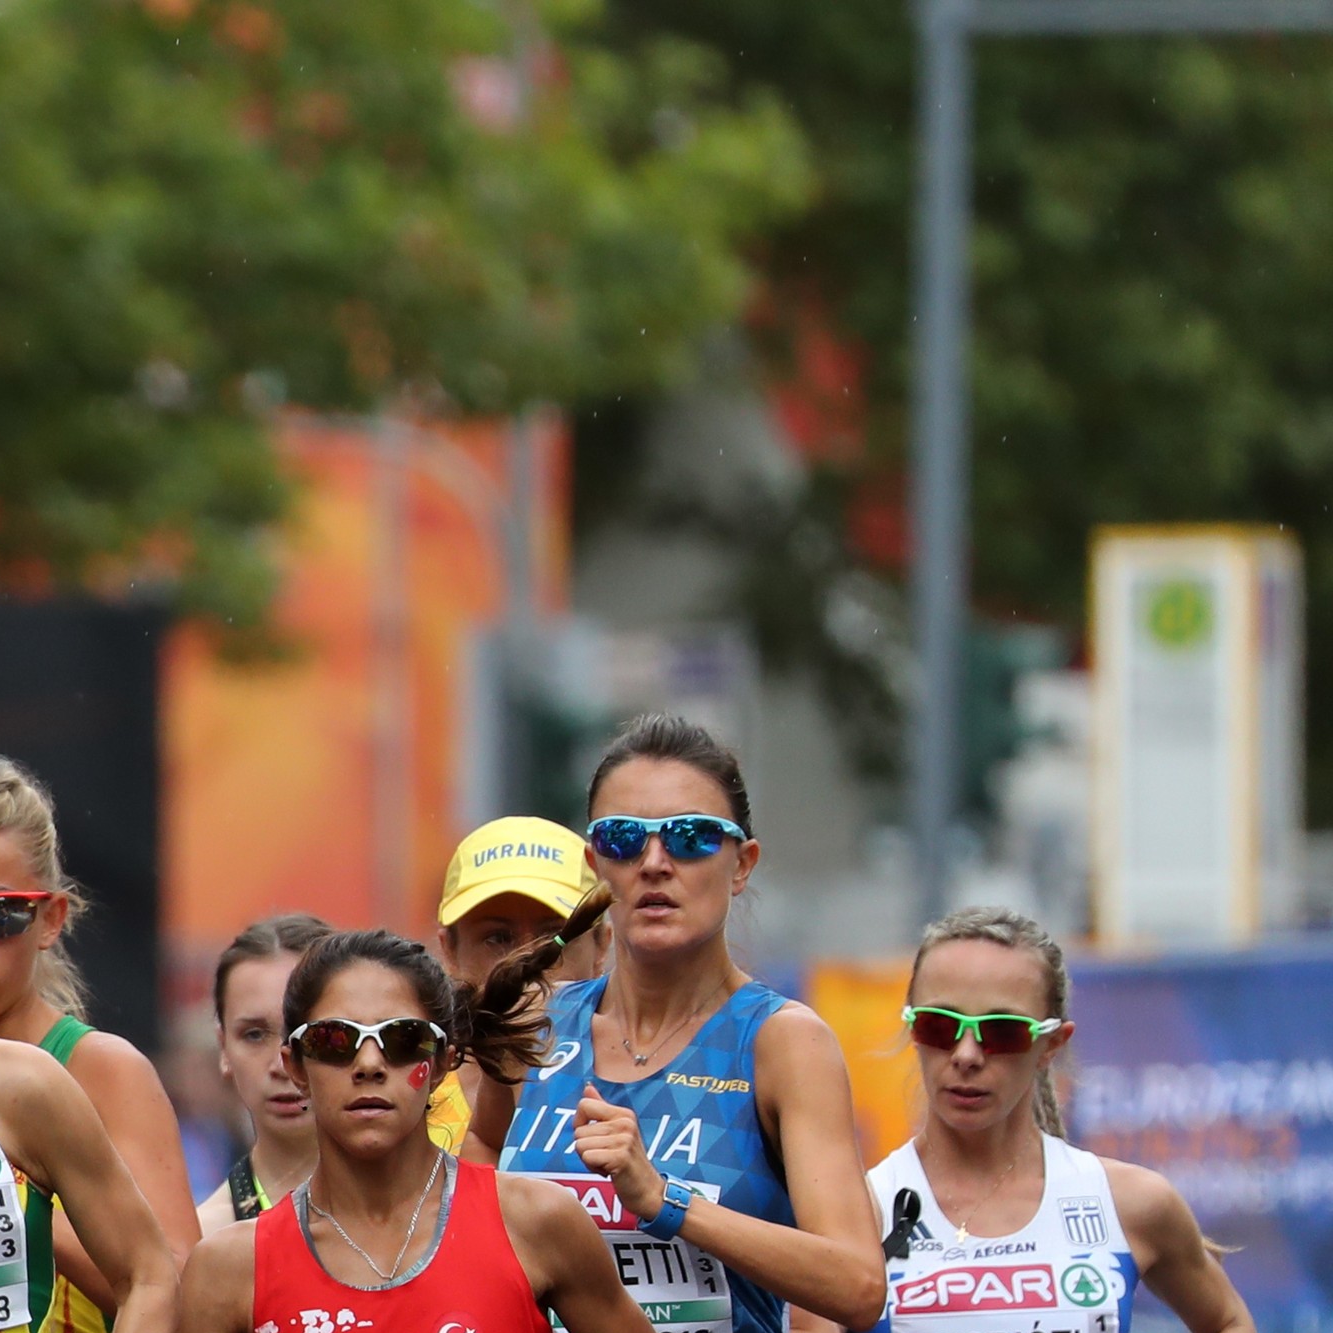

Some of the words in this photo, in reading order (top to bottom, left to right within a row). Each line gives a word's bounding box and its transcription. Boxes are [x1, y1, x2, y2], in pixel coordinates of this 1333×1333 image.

[473, 843, 565, 868] UKRAINE
[520, 1105, 702, 1164] ITIA
[973, 1241, 1036, 1260] AEGEAN
[699, 1248, 717, 1293] 31
[900, 1269, 1053, 1308] SPAR
